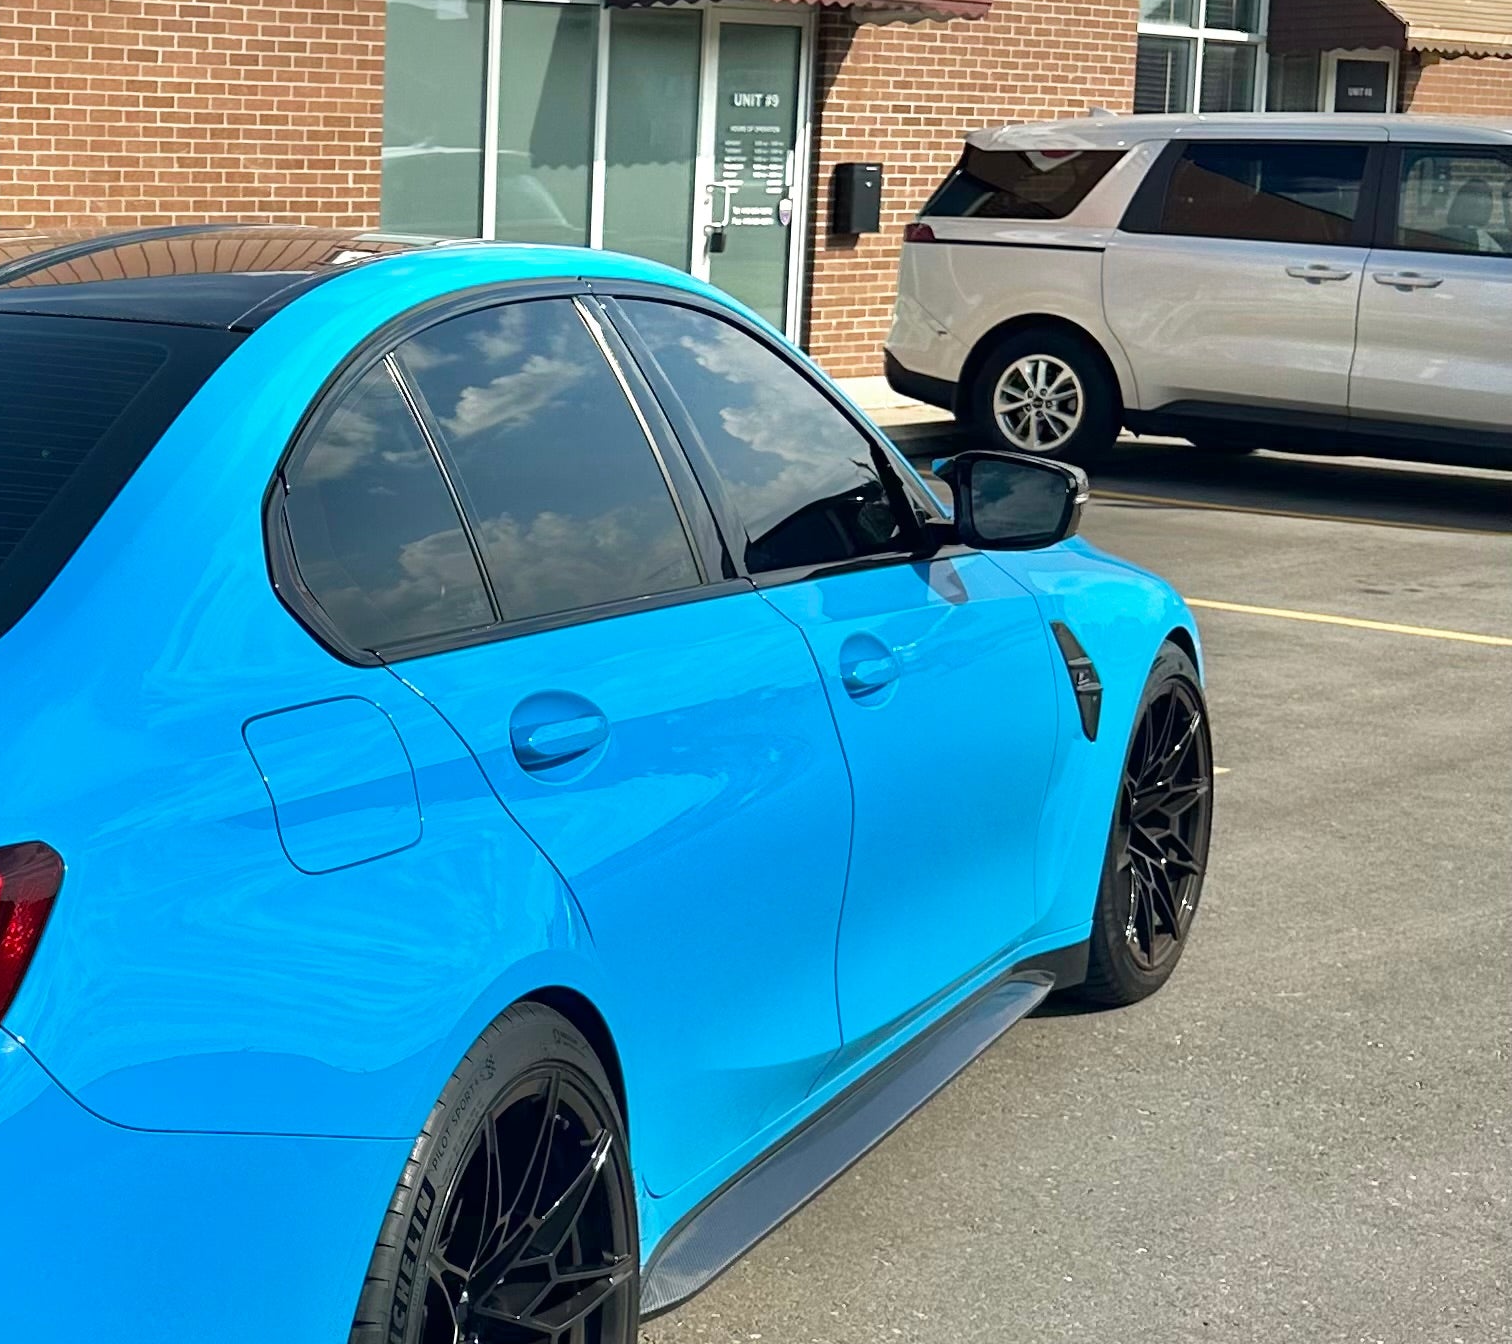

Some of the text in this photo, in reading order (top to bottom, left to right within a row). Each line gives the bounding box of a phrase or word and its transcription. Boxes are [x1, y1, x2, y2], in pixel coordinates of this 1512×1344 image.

[733, 92, 780, 108] UNIT #9
[431, 1126, 451, 1171] PILOT
[450, 1082, 476, 1126] SPORT
